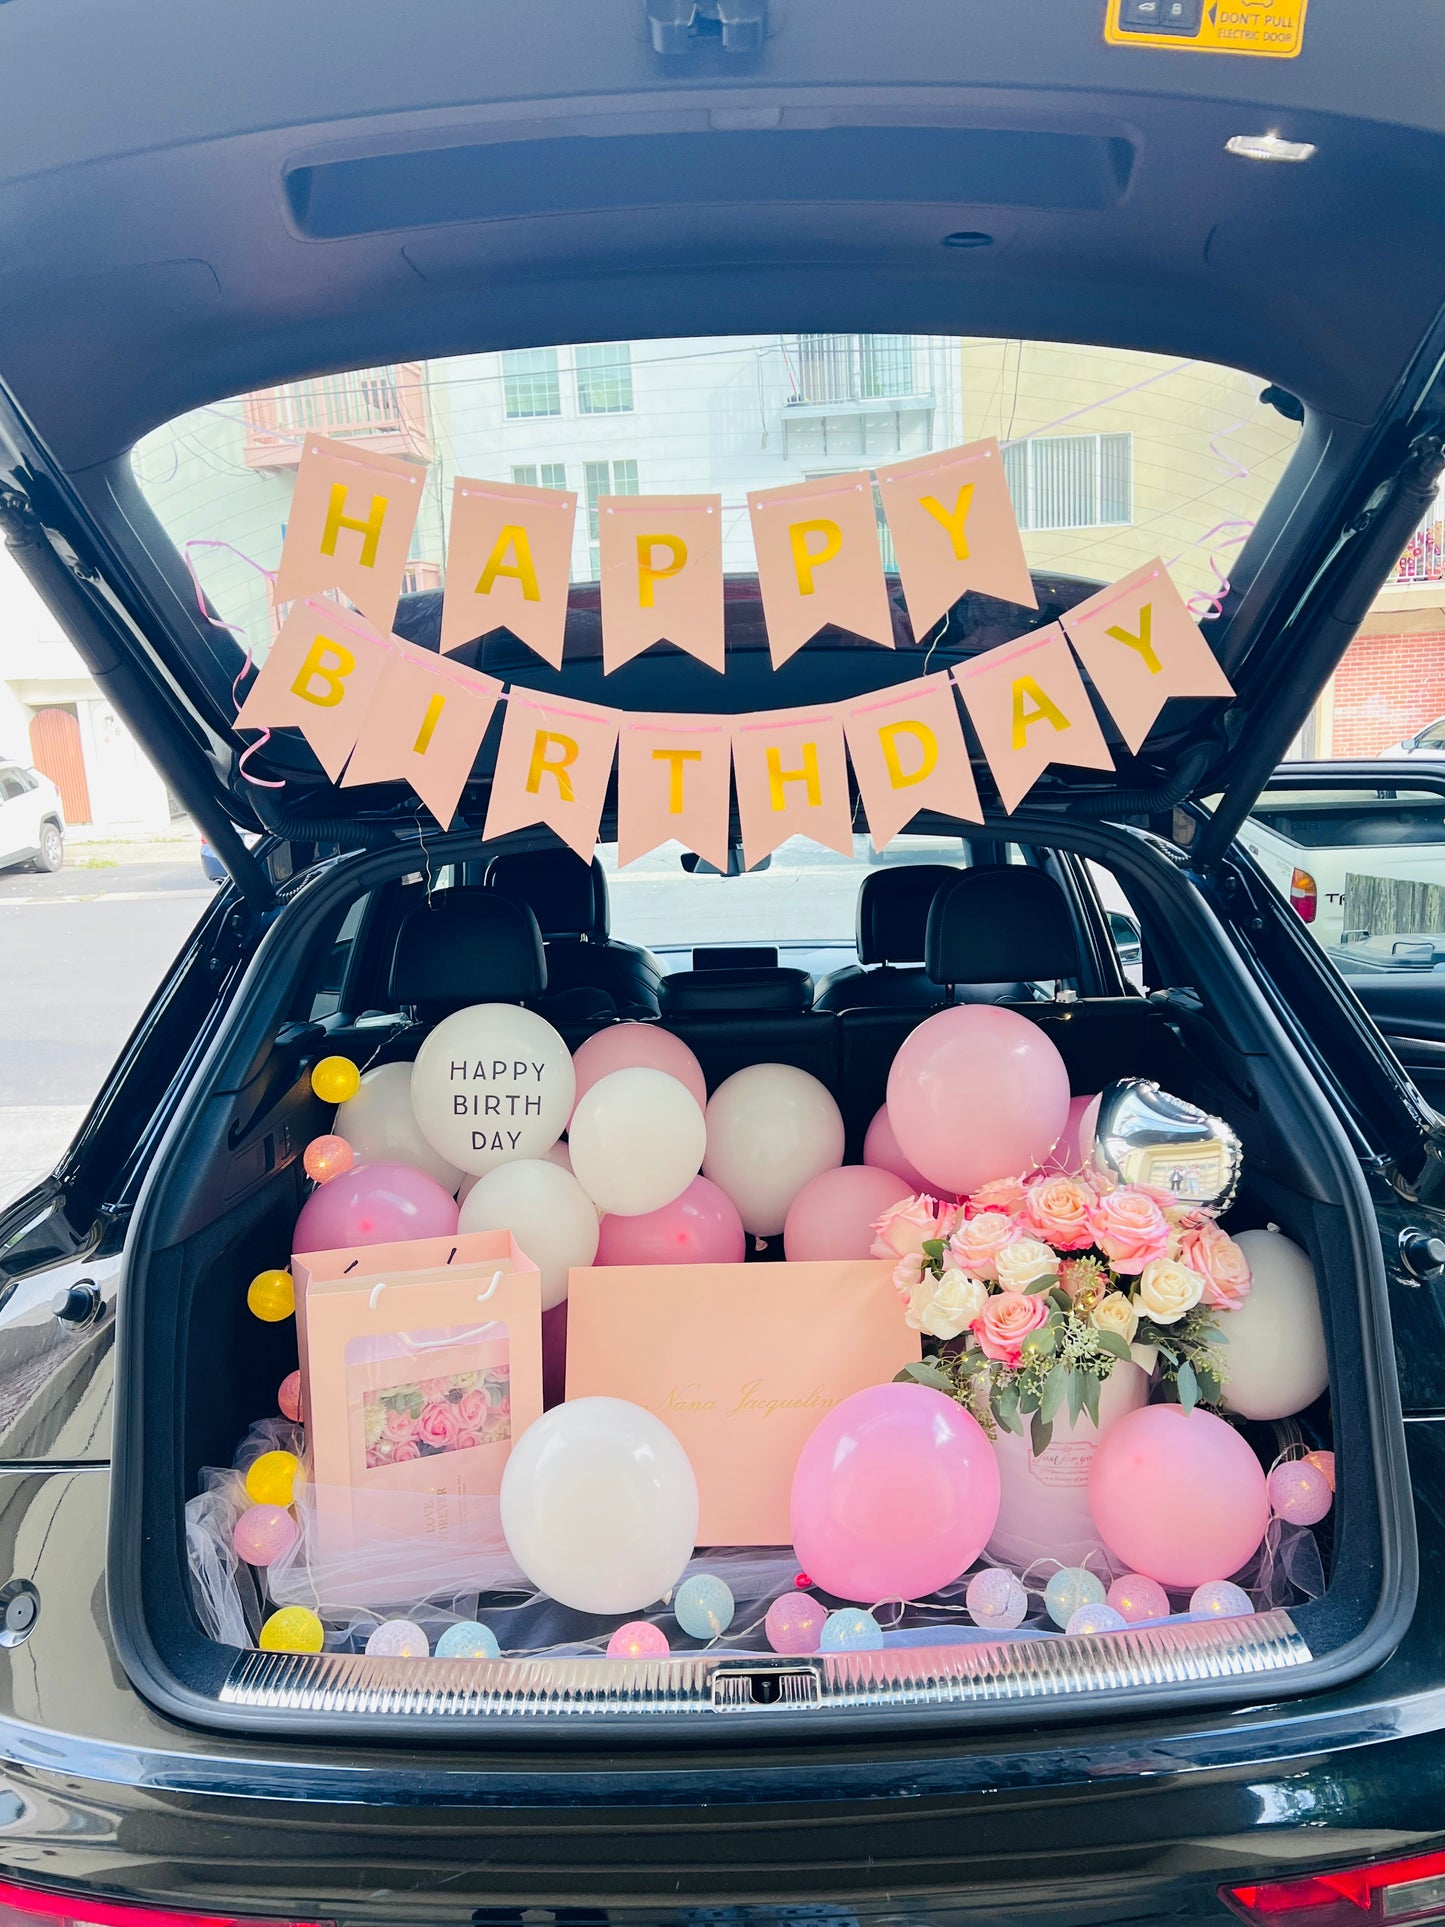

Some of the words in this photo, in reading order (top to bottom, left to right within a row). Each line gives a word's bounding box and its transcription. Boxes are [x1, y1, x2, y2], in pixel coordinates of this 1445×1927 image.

[1219, 12, 1260, 26] DON'T
[1264, 15, 1294, 28] PULL
[1217, 28, 1259, 41] ELECTRIC
[1263, 32, 1292, 43] DOOR
[319, 482, 976, 610] HAPPY
[289, 601, 1164, 816] BIRTHDAY
[450, 1060, 545, 1082] HAPPY
[453, 1094, 541, 1116] BIRTH
[471, 1130, 522, 1151] DAY
[644, 1384, 718, 1413] Nana
